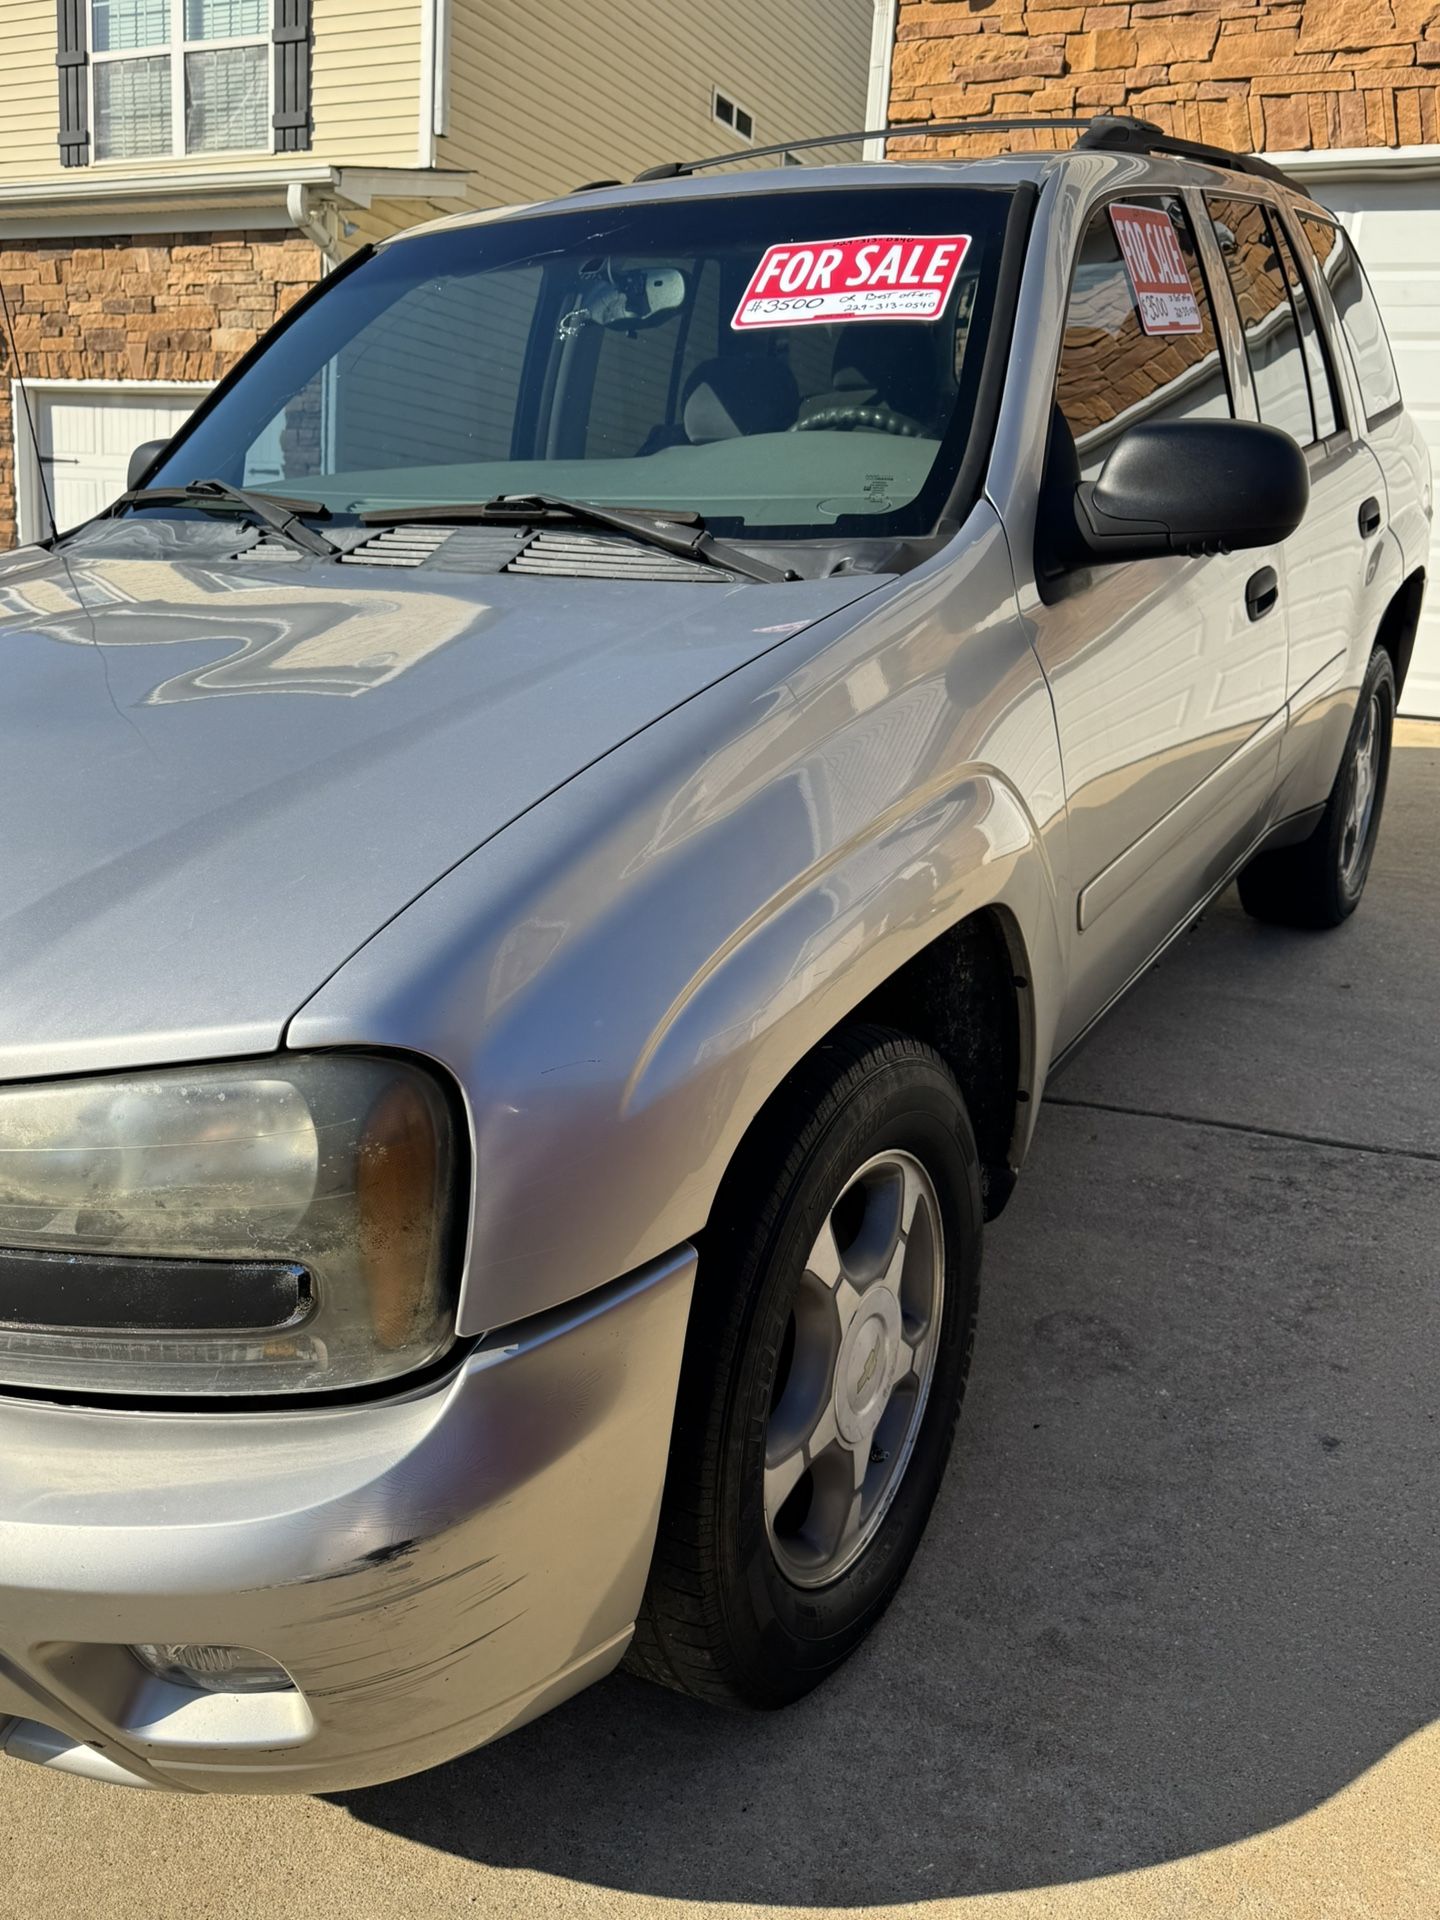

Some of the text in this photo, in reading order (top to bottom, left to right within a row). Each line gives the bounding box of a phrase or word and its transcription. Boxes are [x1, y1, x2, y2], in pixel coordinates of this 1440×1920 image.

[754, 244, 958, 293] FOR SALE
[1115, 219, 1188, 285] FOR SALE
